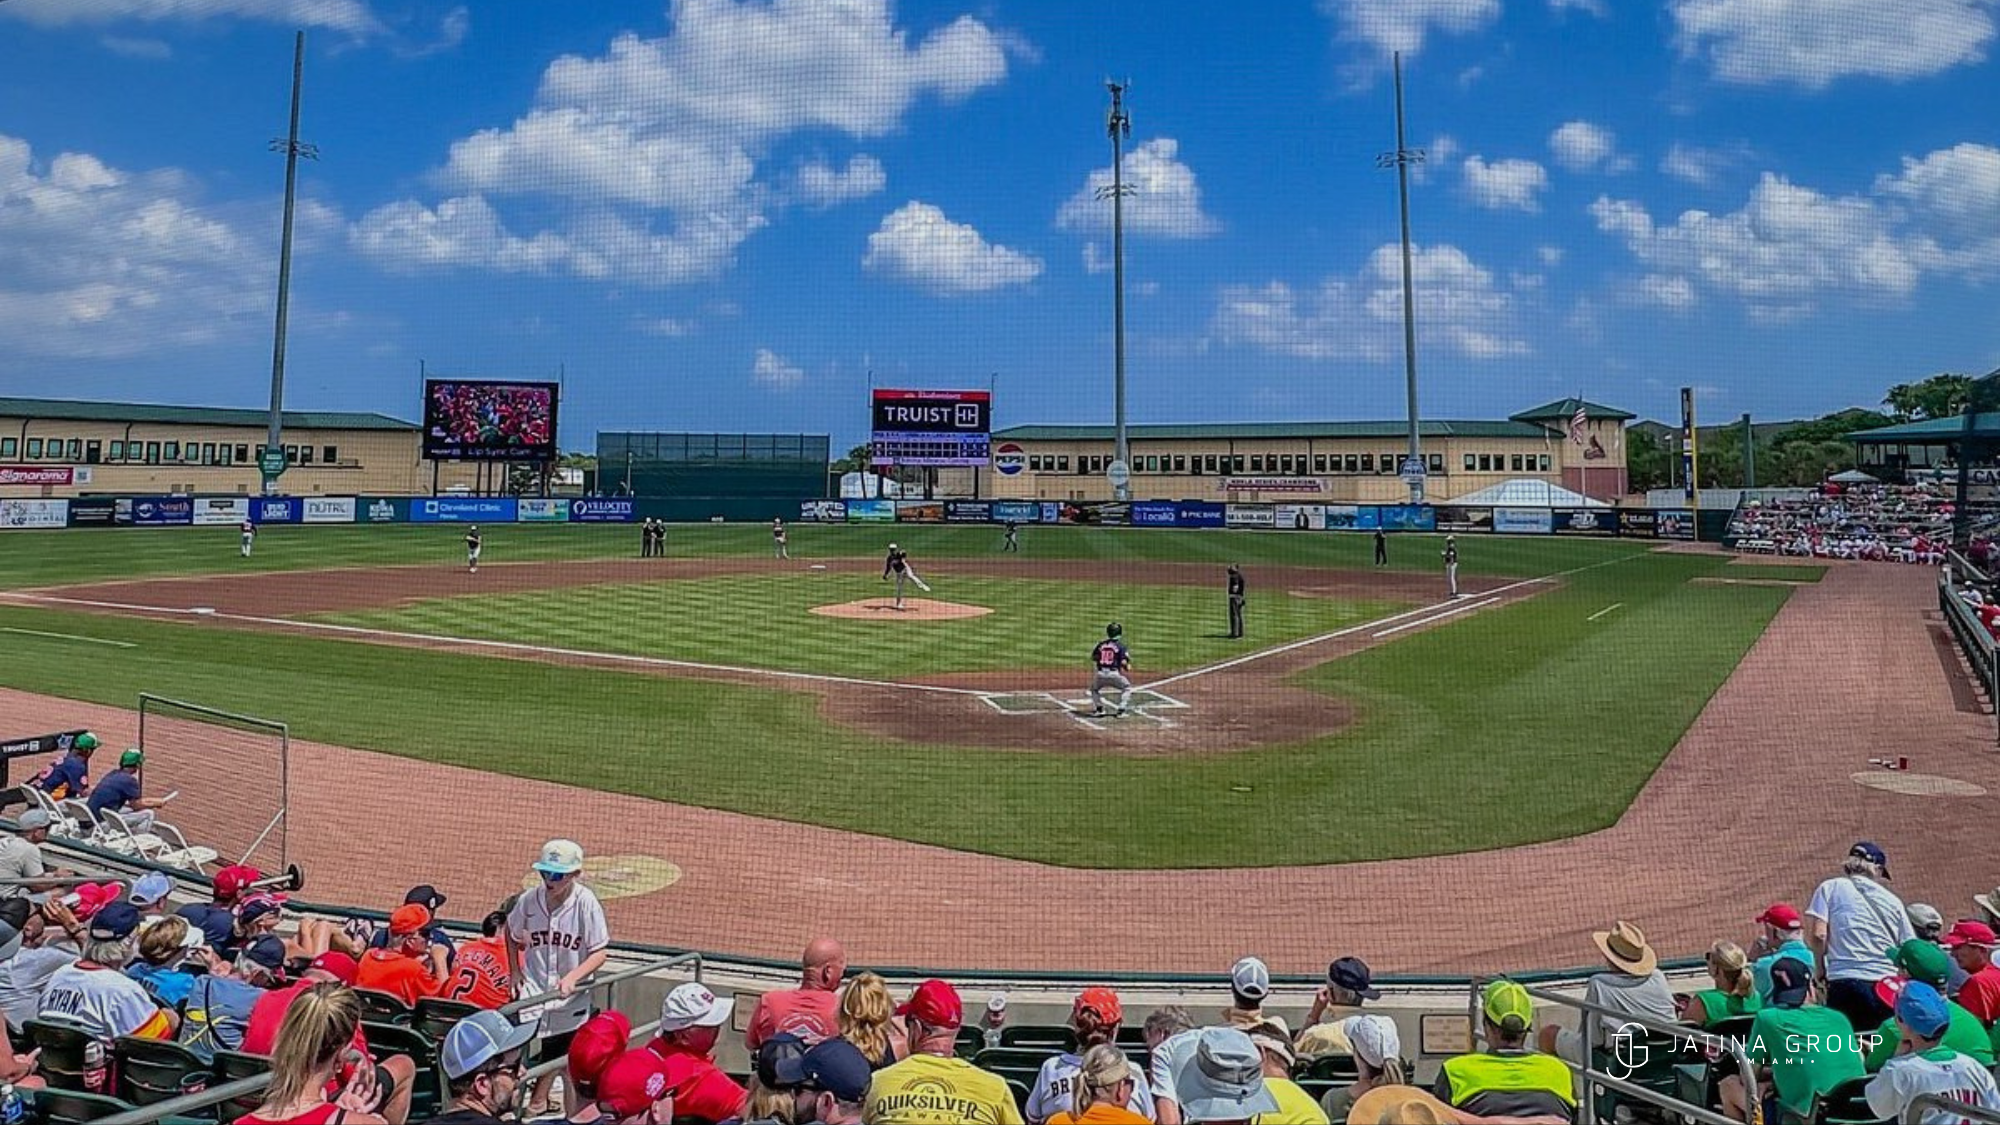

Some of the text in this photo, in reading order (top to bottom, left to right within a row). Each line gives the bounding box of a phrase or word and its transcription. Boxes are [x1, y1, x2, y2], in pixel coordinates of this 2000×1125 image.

[884, 406, 951, 422] TRUIST
[588, 502, 632, 511] VELOCITY
[530, 931, 582, 951] STROS
[452, 968, 478, 1000] 2
[47, 988, 84, 1016] RYAN
[877, 1095, 978, 1120] QUIKSILVER
